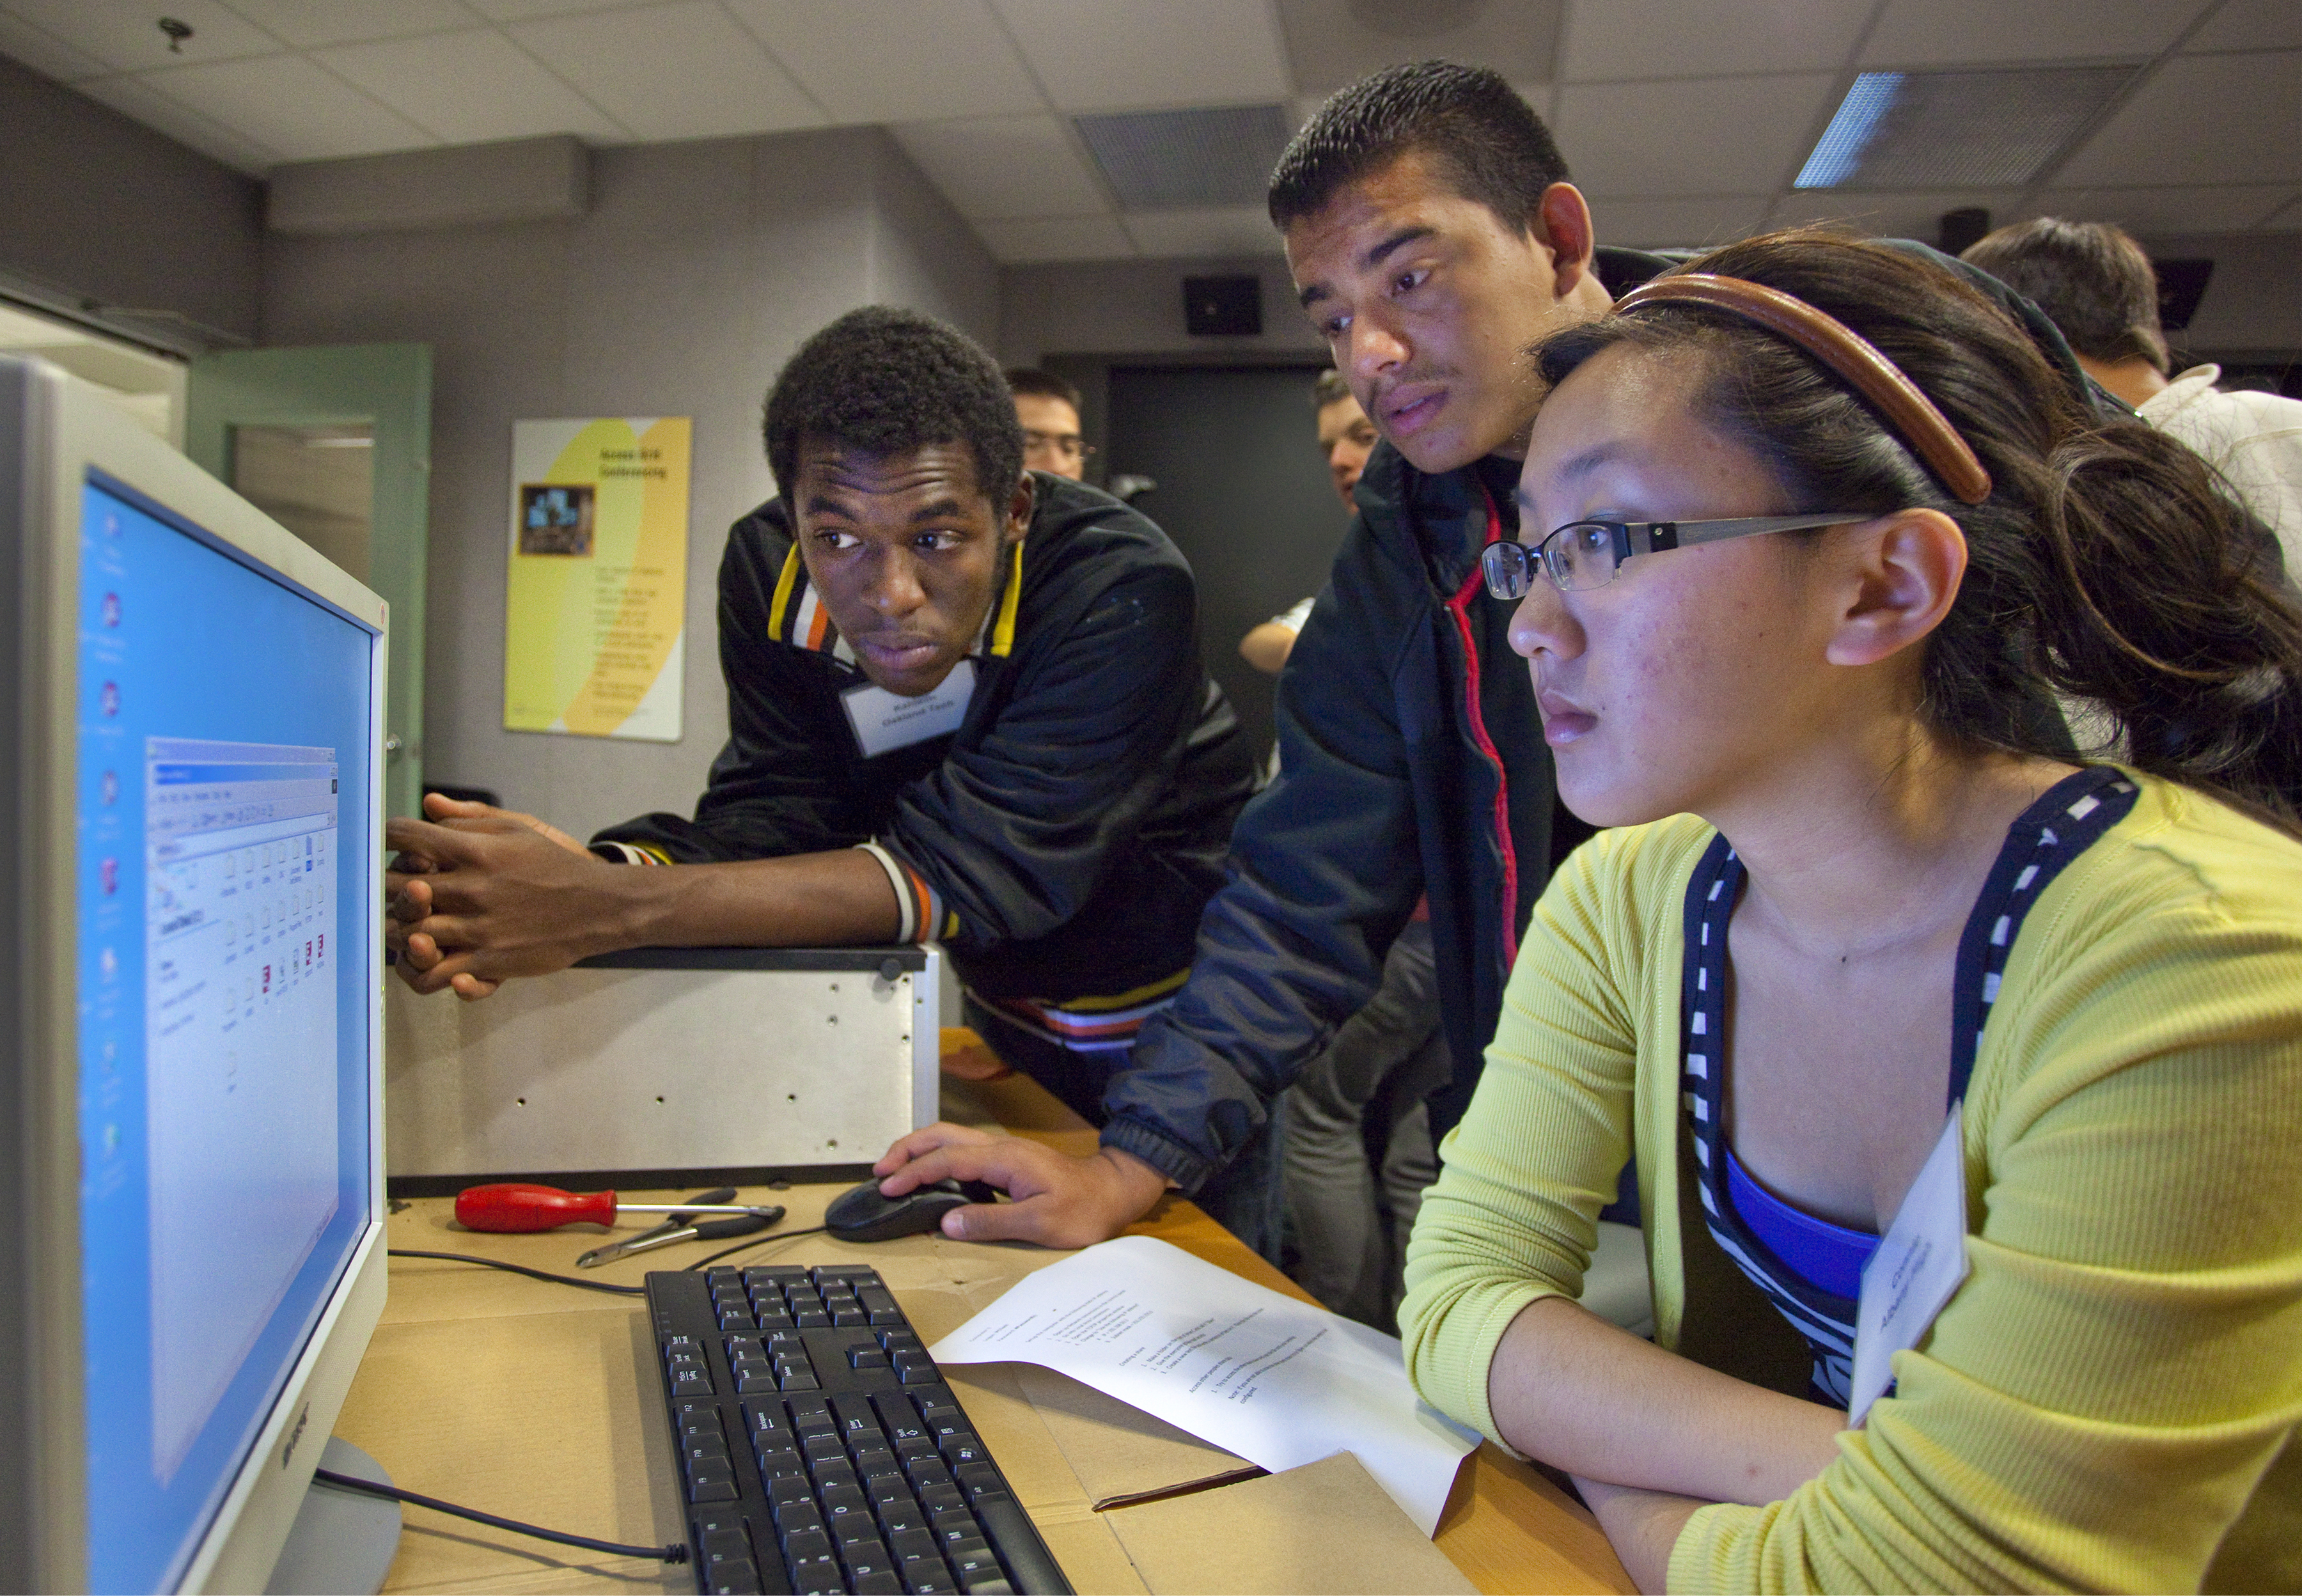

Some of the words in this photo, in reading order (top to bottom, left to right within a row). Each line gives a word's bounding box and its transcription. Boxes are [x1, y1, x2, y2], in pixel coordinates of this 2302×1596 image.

[1119, 1355, 1136, 1366] Creating
[1167, 1360, 1178, 1369] Create
[1189, 1382, 1202, 1393] Access
[1228, 1391, 1239, 1399] Note:
[1241, 1388, 1257, 1404] configured.
[758, 1412, 768, 1430] Backspace
[849, 1420, 857, 1429] Enter
[897, 1428, 907, 1437] Shift
[693, 1449, 702, 1457] F10
[948, 1531, 962, 1540] M
[964, 1562, 978, 1570] N
[857, 1567, 871, 1575] U
[920, 1584, 934, 1593] H
